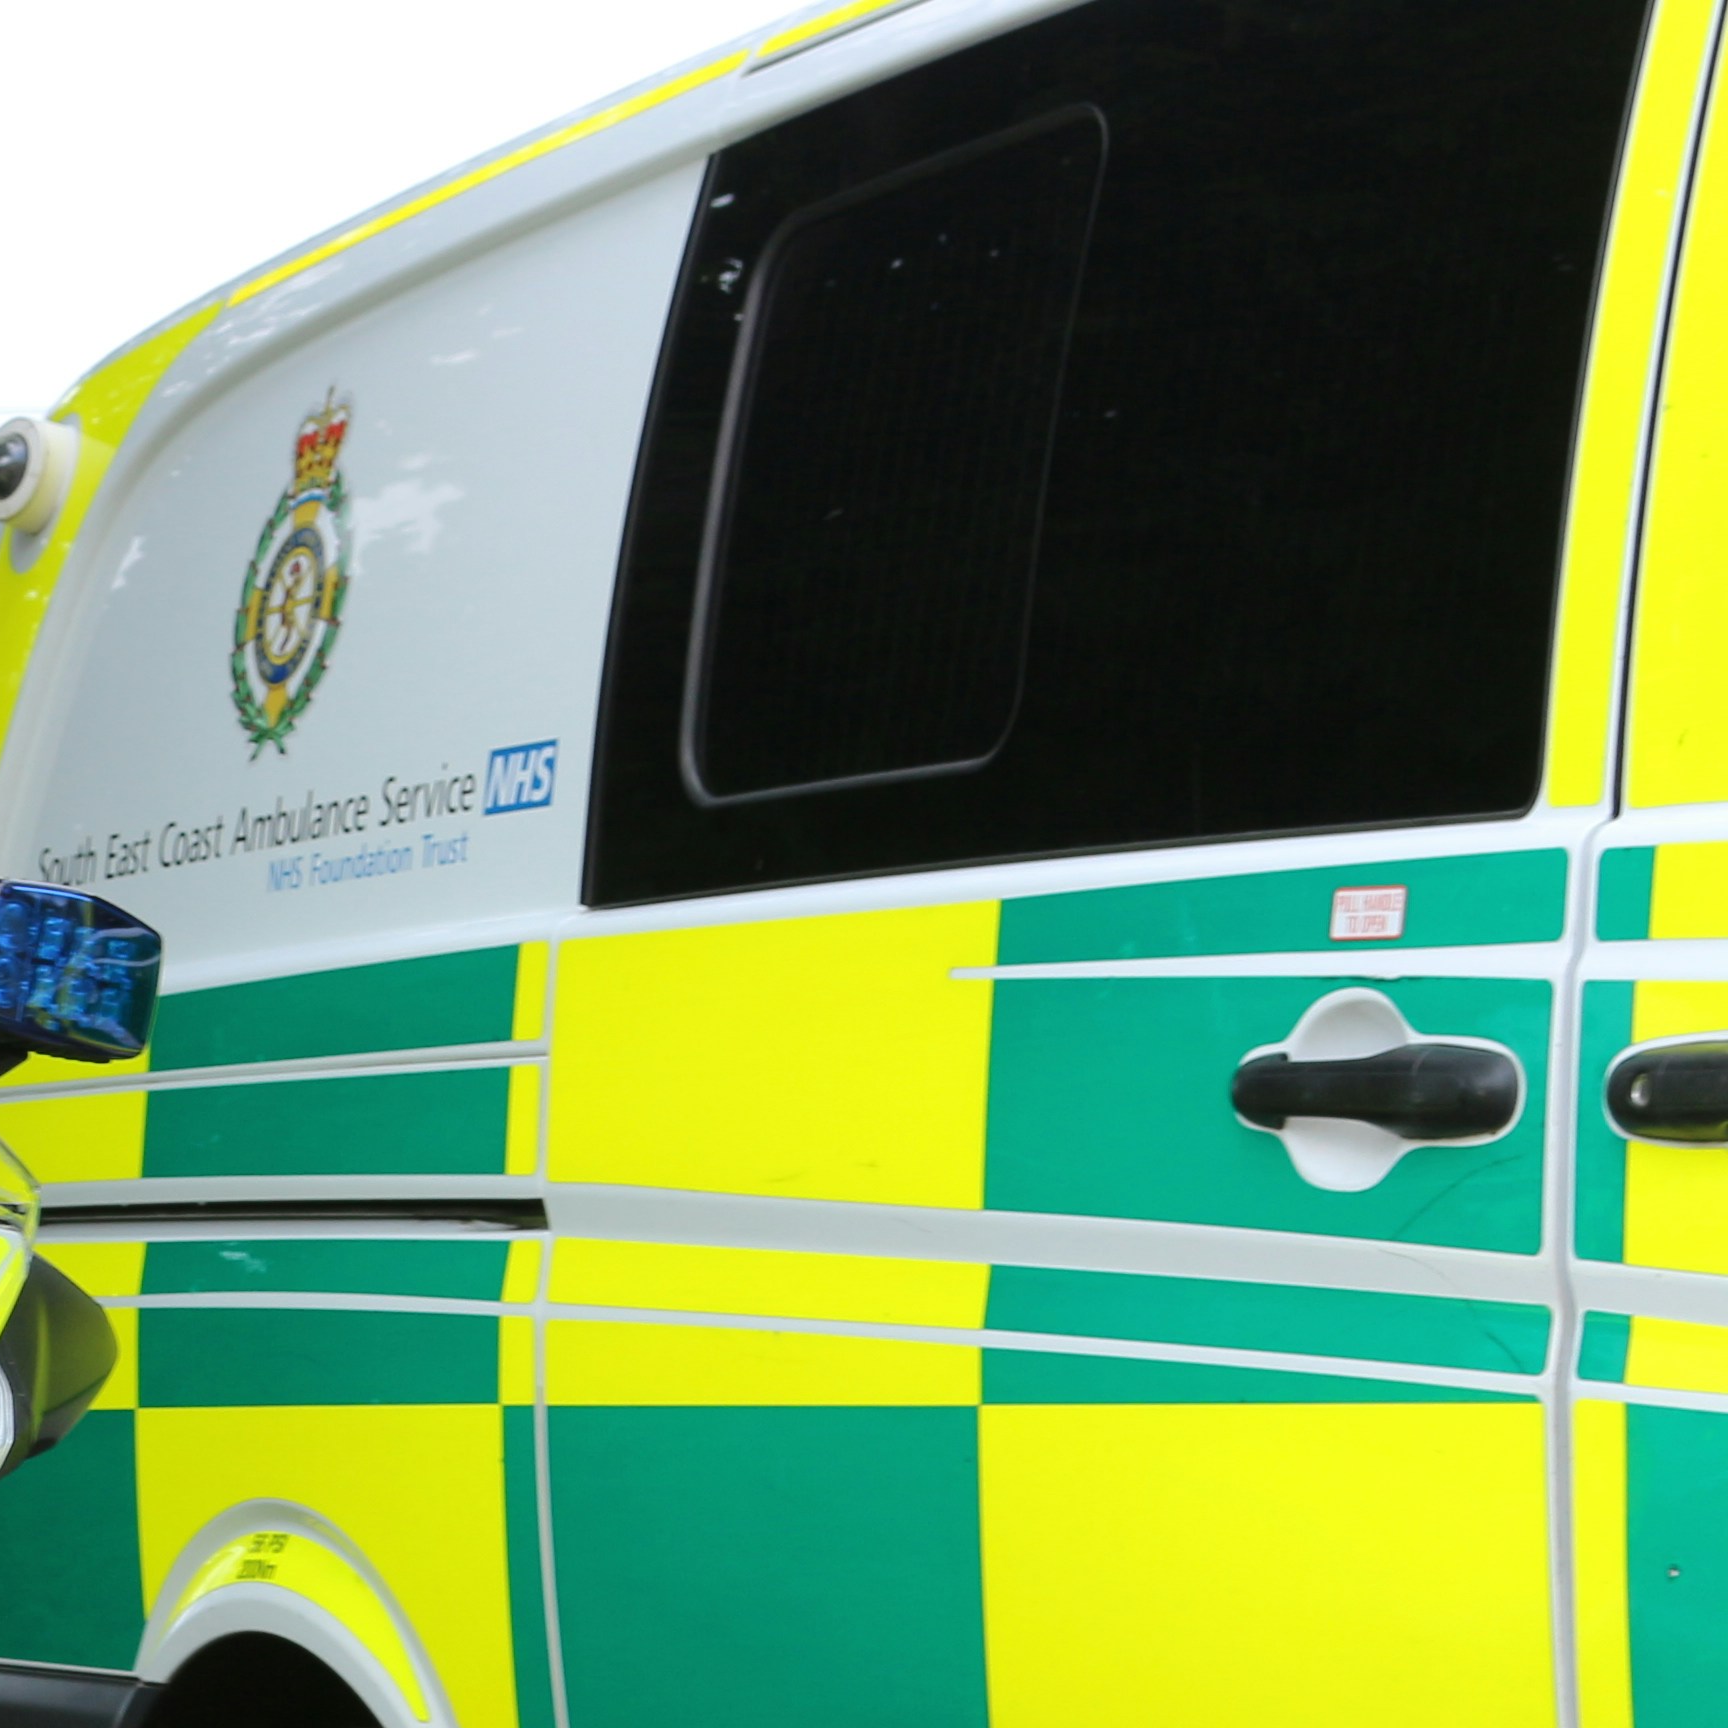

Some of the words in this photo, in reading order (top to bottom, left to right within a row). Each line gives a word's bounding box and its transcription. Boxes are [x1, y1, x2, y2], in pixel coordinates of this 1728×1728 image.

[485, 744, 555, 810] NHS
[38, 836, 97, 885] South
[104, 831, 152, 879] East
[158, 816, 224, 868] Coast
[230, 789, 370, 855] Ambulance
[378, 762, 476, 828] Service
[267, 855, 304, 892] NHS
[309, 840, 414, 887] Foundation
[421, 832, 469, 869] Trust
